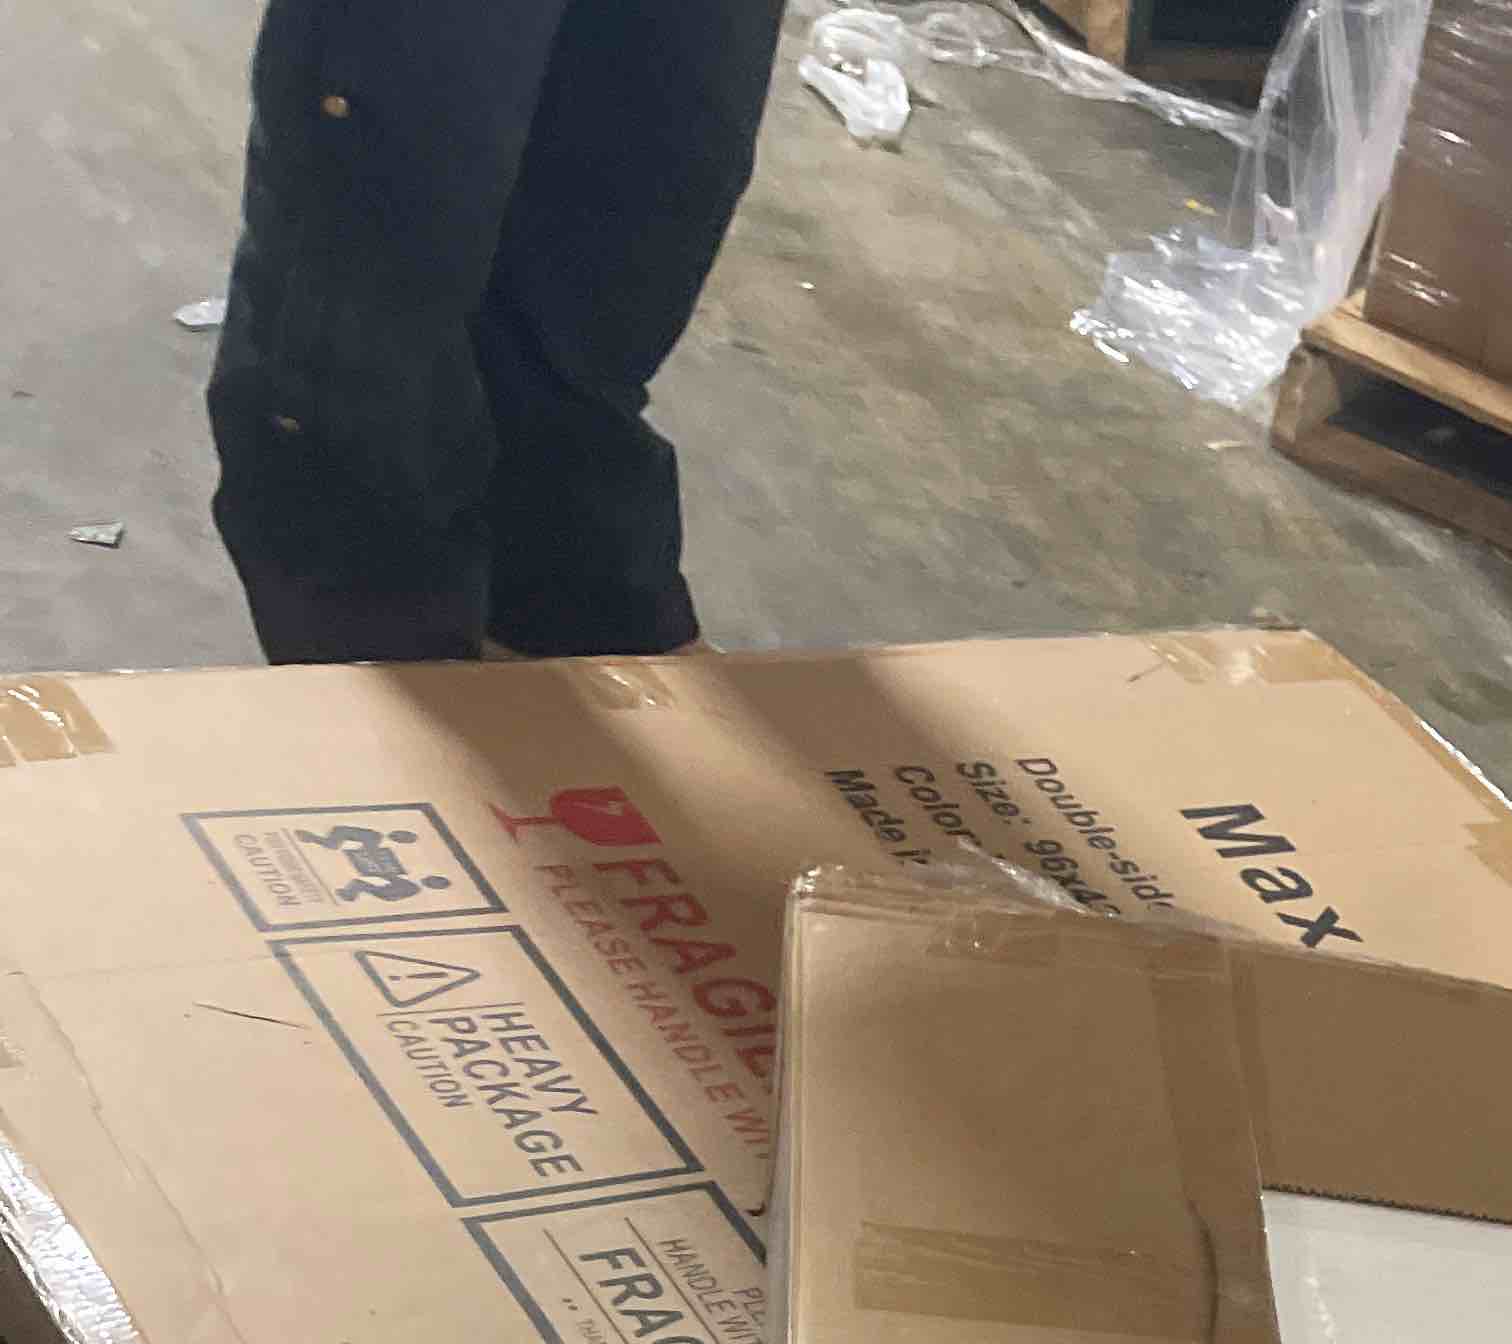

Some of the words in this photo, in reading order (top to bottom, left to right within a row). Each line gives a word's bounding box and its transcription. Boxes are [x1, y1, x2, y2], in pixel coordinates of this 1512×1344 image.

[825, 768, 908, 843] Made
[234, 834, 301, 906] CAUTION
[1180, 804, 1364, 948] Max
[534, 864, 647, 975] PLEASE
[627, 983, 745, 1102] HANDLE
[592, 858, 777, 1094] FRAGIL
[387, 1020, 473, 1107] CAUTION
[428, 1016, 584, 1177] PACKAGE
[481, 1011, 599, 1115] HEAVY
